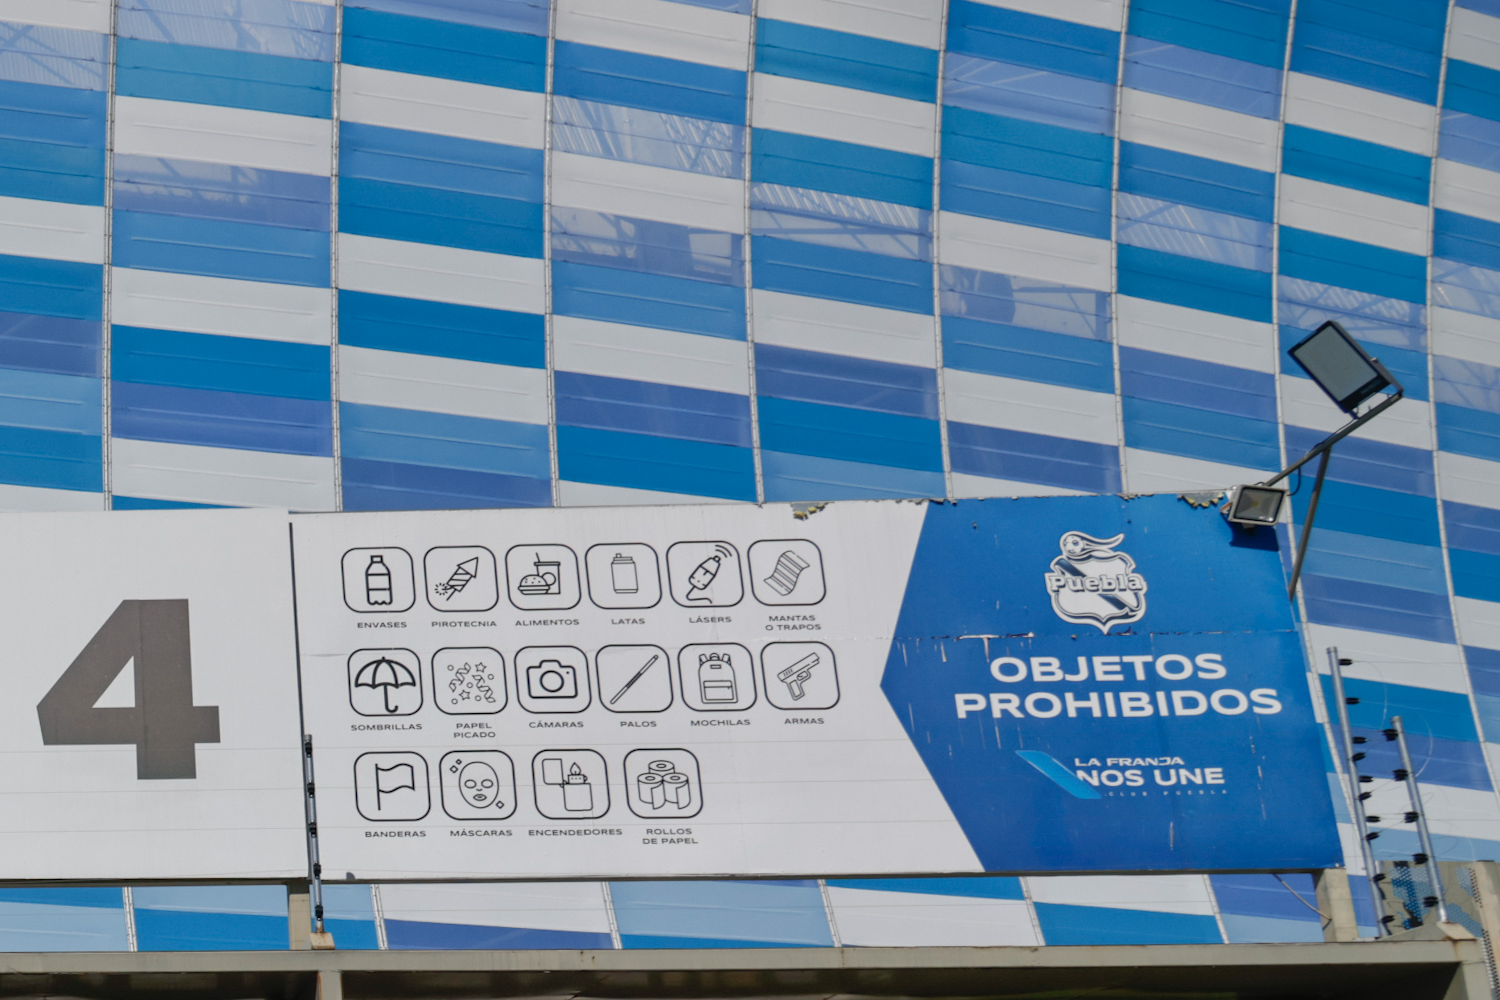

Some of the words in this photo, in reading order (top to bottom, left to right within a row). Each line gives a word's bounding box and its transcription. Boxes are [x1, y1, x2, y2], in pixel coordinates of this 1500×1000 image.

[1050, 573, 1144, 592] Puebla
[611, 617, 646, 625] LATAS
[689, 615, 732, 624] LÁSERS
[768, 614, 816, 622] MANTAS
[357, 621, 407, 629] ENVASES
[431, 620, 497, 628] PIROTECNIA
[515, 618, 580, 627] ALIMENTOS
[777, 623, 822, 631] TRAPOS
[990, 653, 1227, 683] OBJETOS
[36, 598, 221, 779] 4
[954, 688, 1283, 719] PROHIBIDOS
[529, 720, 584, 729] CÁMARAS
[620, 720, 657, 728] PALOS
[784, 717, 825, 725] ARMAS
[351, 723, 423, 731] SOMBRILLAS
[1075, 757, 1101, 767] LA
[1106, 756, 1185, 767] FRANJA
[1075, 770, 1145, 787] NOS
[1154, 768, 1225, 786] UNE
[365, 830, 426, 838] BANDERAS
[450, 828, 513, 837] MÁSCARAS
[528, 828, 623, 836] ENCENDEDORES
